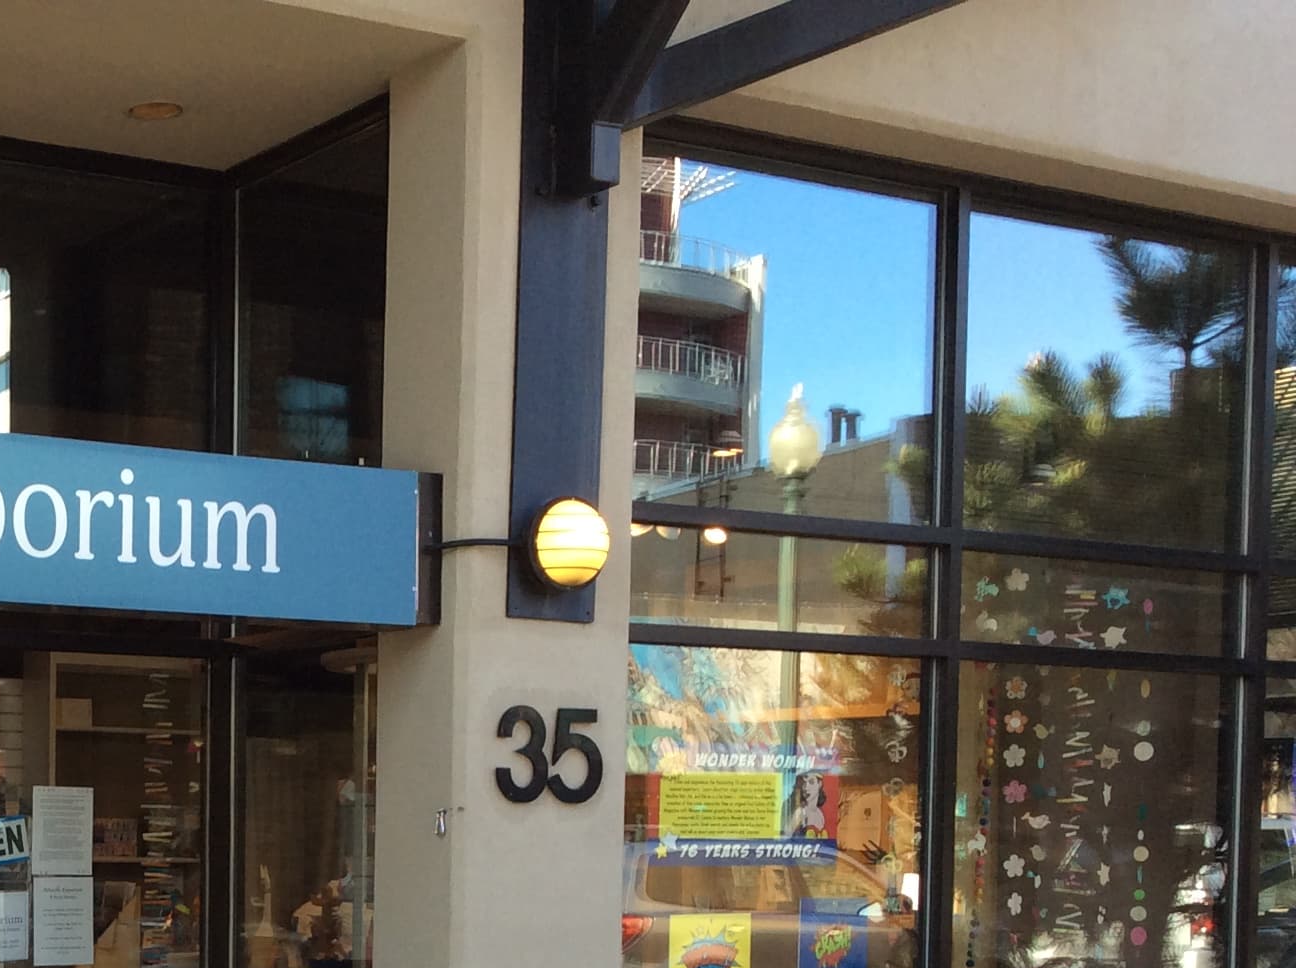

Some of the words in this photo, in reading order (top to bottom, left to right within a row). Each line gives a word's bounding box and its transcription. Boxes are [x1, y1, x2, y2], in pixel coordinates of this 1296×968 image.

[495, 704, 603, 804] 35
[695, 752, 756, 768] WONDER
[761, 752, 816, 769] WOMAN
[704, 844, 752, 859] YEARS
[754, 843, 822, 859] STRONG!
